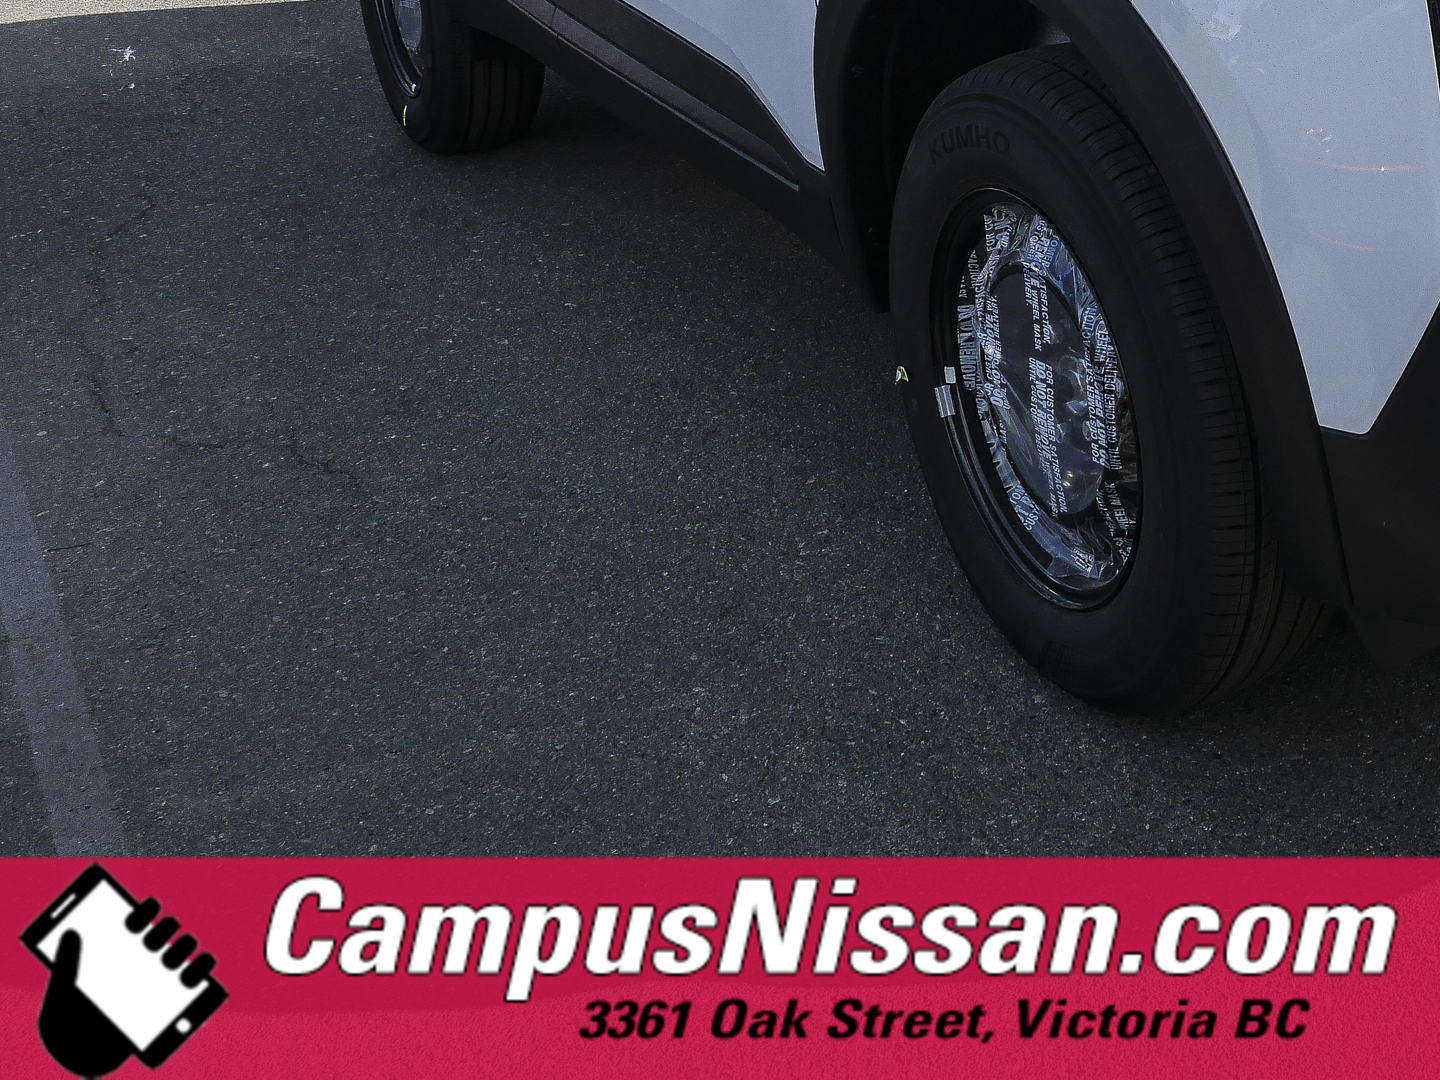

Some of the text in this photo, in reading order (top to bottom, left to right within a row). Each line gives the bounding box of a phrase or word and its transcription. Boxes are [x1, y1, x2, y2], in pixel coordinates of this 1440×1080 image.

[927, 124, 1011, 165] KUMHO
[1027, 218, 1046, 260] USTOMER
[990, 295, 1000, 339] DELIVERY.
[1031, 289, 1041, 321] WHEEL
[1033, 323, 1043, 352] MASK
[1035, 360, 1046, 380] DO
[1045, 364, 1054, 385] FOR
[1035, 380, 1047, 409] NOT
[1046, 387, 1057, 442] CUSTOMER
[1086, 384, 1098, 441] CUSTOMER
[1103, 393, 1118, 443] CUSTOMER
[1036, 409, 1052, 461] REMOVE
[1096, 419, 1108, 448] NOT
[1090, 442, 1100, 464] FOR
[1099, 449, 1111, 469] DO
[1107, 446, 1123, 470] UNTIL
[1104, 481, 1122, 506] MASK
